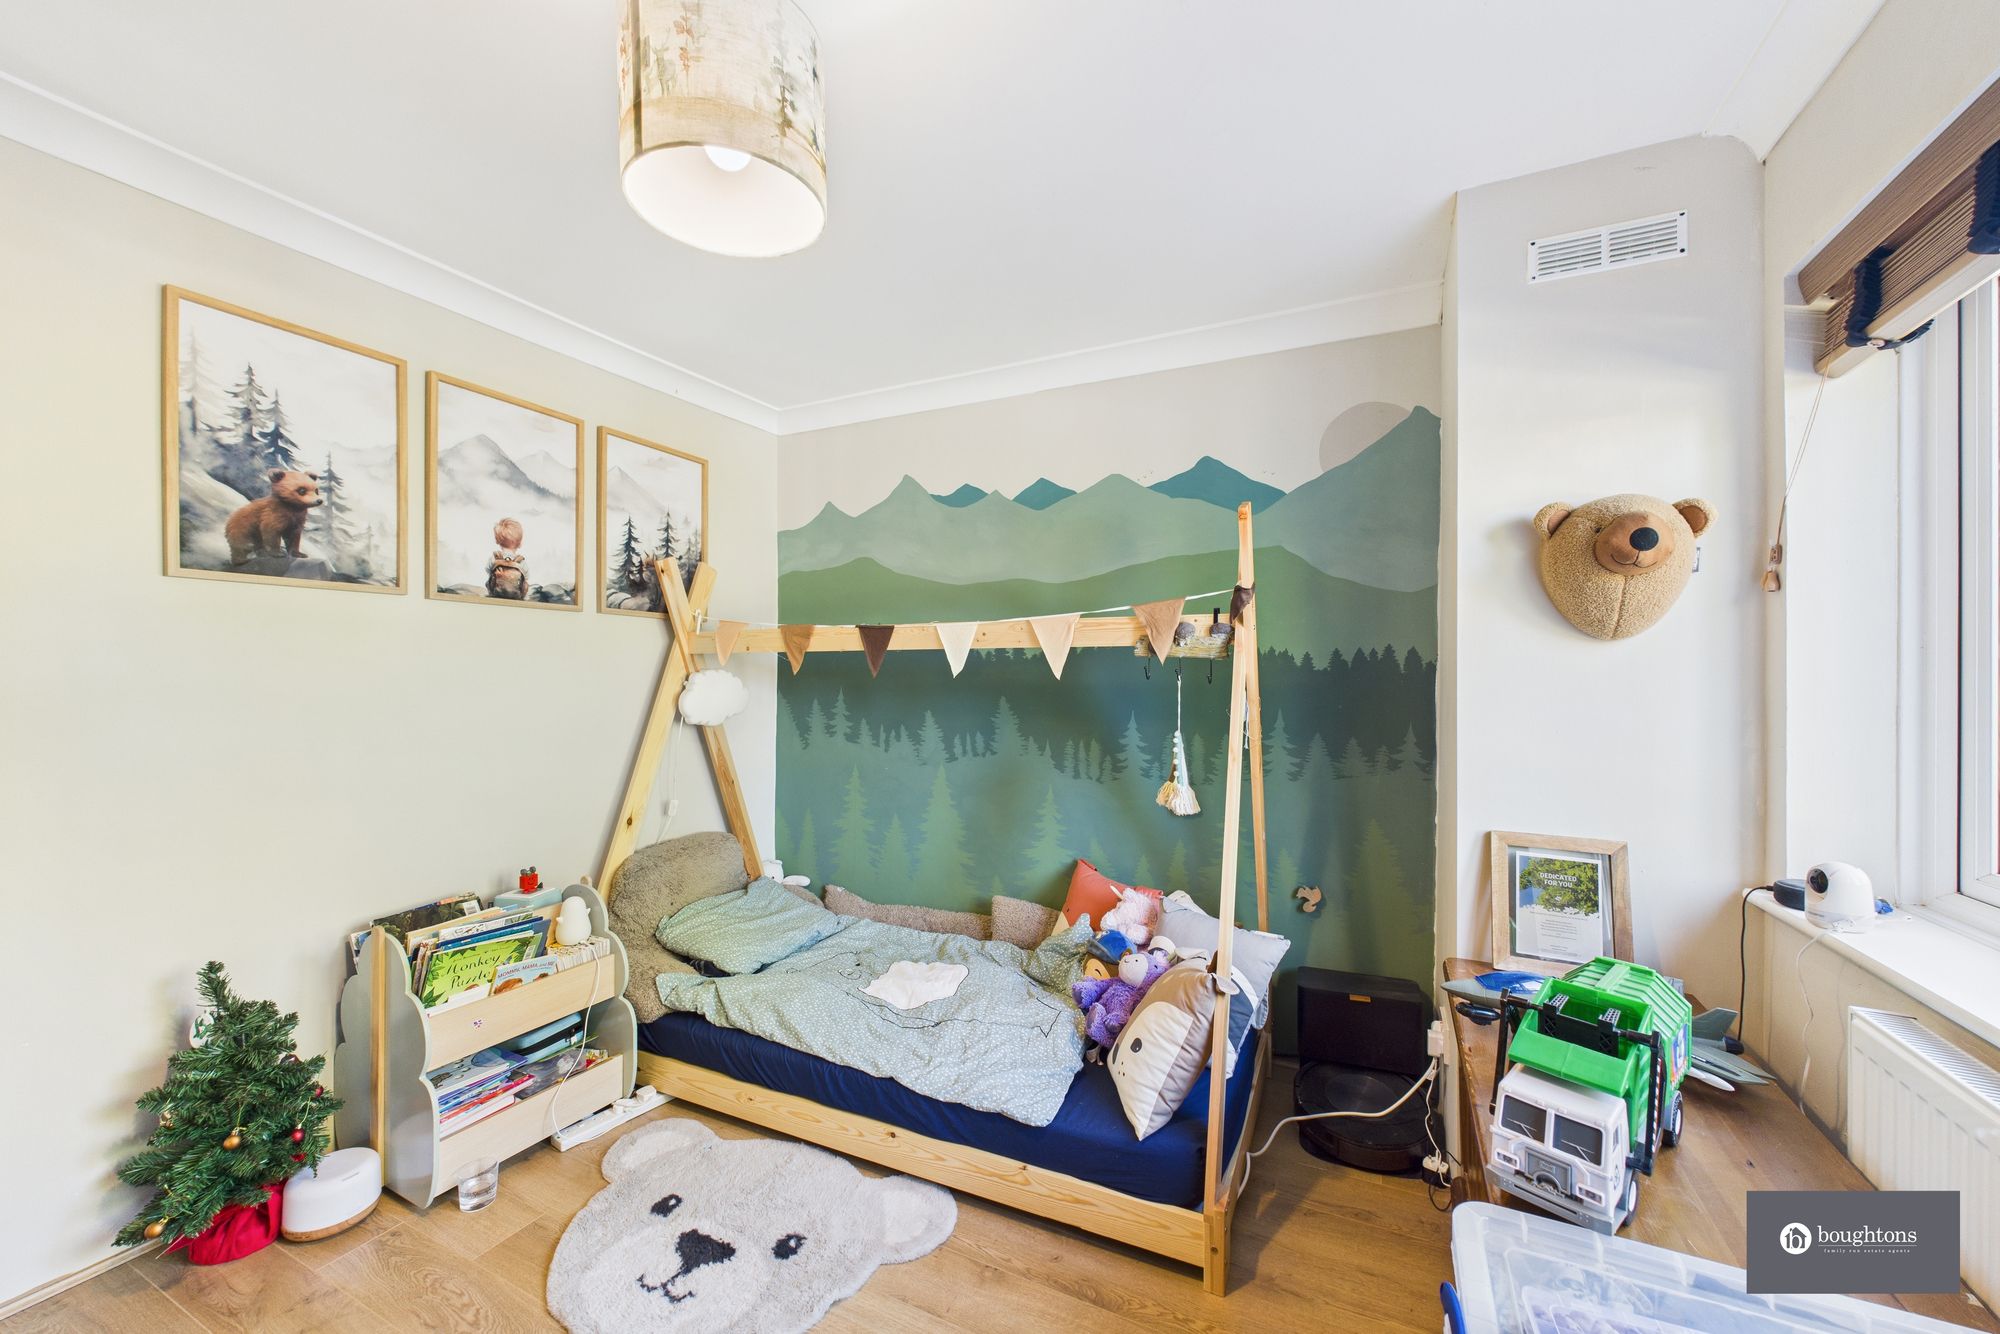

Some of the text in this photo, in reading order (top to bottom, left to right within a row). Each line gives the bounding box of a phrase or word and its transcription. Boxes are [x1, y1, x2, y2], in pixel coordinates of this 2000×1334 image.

[1540, 872, 1577, 882] DEDICATED
[1544, 879, 1573, 888] FOR YOU
[446, 955, 501, 975] Monkey
[451, 970, 491, 989] Puzzle
